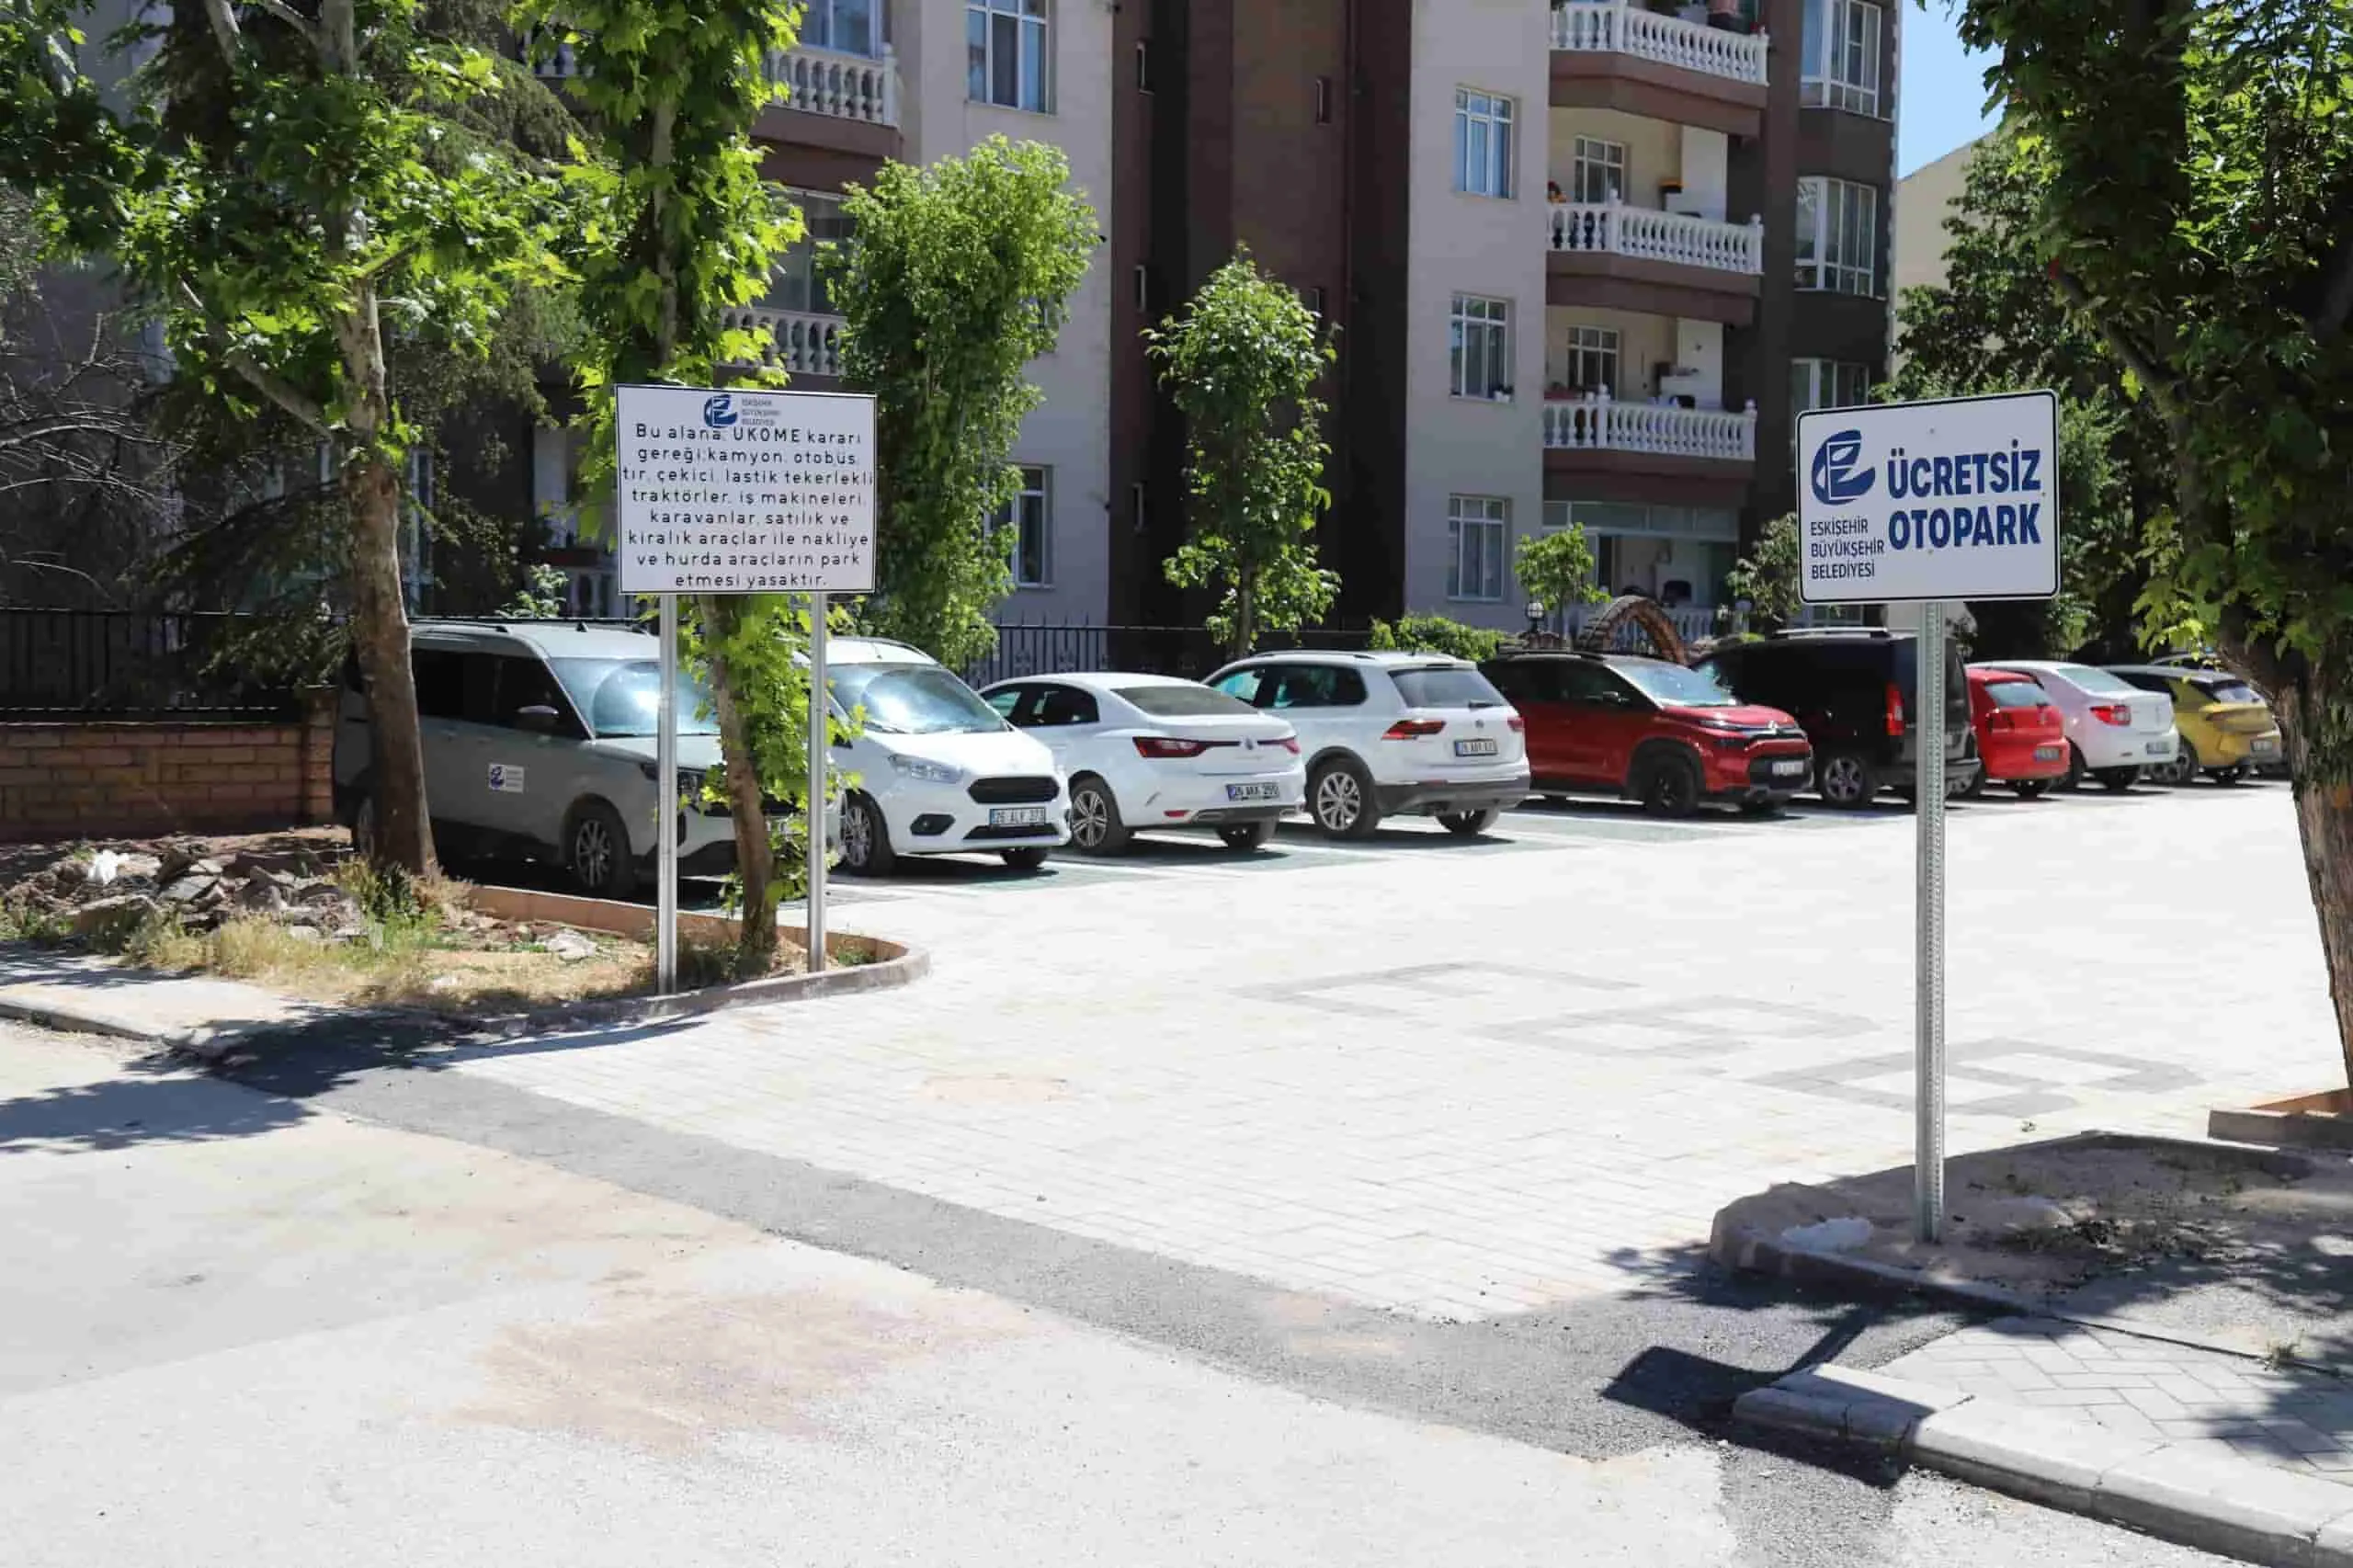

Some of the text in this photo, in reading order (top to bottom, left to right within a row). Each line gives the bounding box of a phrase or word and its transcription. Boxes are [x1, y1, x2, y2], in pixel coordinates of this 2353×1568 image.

[636, 423, 661, 439] Bu
[733, 426, 801, 442] UKOME
[807, 427, 861, 444] kararı
[638, 447, 701, 464] gereği
[726, 469, 778, 484] lastik
[784, 470, 873, 485] tekerlekli
[1887, 438, 2041, 499] ÜCRETSİZ
[765, 511, 824, 525] satılık
[830, 514, 849, 525] ve
[1811, 516, 1869, 537] ESKİŞEHİR
[1888, 503, 2041, 551] OTOPARK
[699, 529, 767, 547] araçlar
[773, 531, 795, 545] ile
[801, 530, 869, 549] nakliye
[1811, 537, 1885, 558] BÜYÜKŞEHİR
[637, 551, 860, 569] ve hurda araçların park
[1812, 559, 1875, 579] BELEDİYESİ
[676, 574, 740, 586] etmesi
